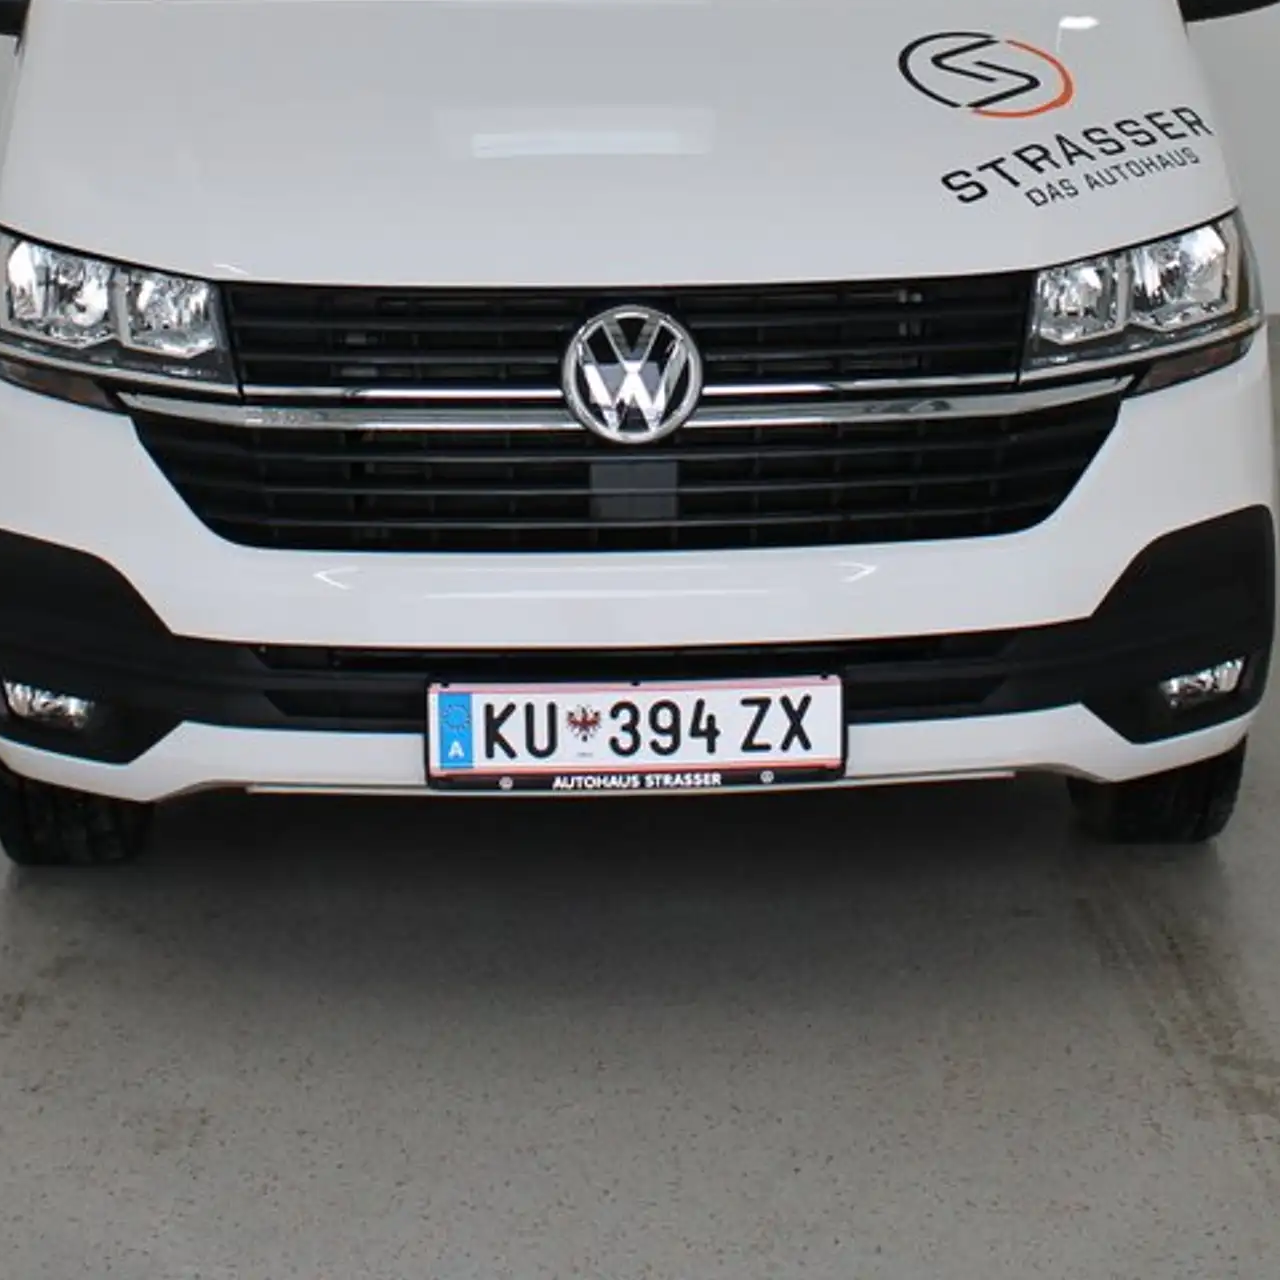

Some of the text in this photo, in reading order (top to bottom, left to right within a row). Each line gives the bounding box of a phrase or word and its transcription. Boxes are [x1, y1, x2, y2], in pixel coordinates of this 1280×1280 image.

[941, 107, 1214, 204] STRASSER
[1024, 146, 1201, 208] DAS AUTOHAUS
[484, 694, 813, 759] KU 394 ZX
[552, 771, 722, 790] AUTOHAUS STRASSER
